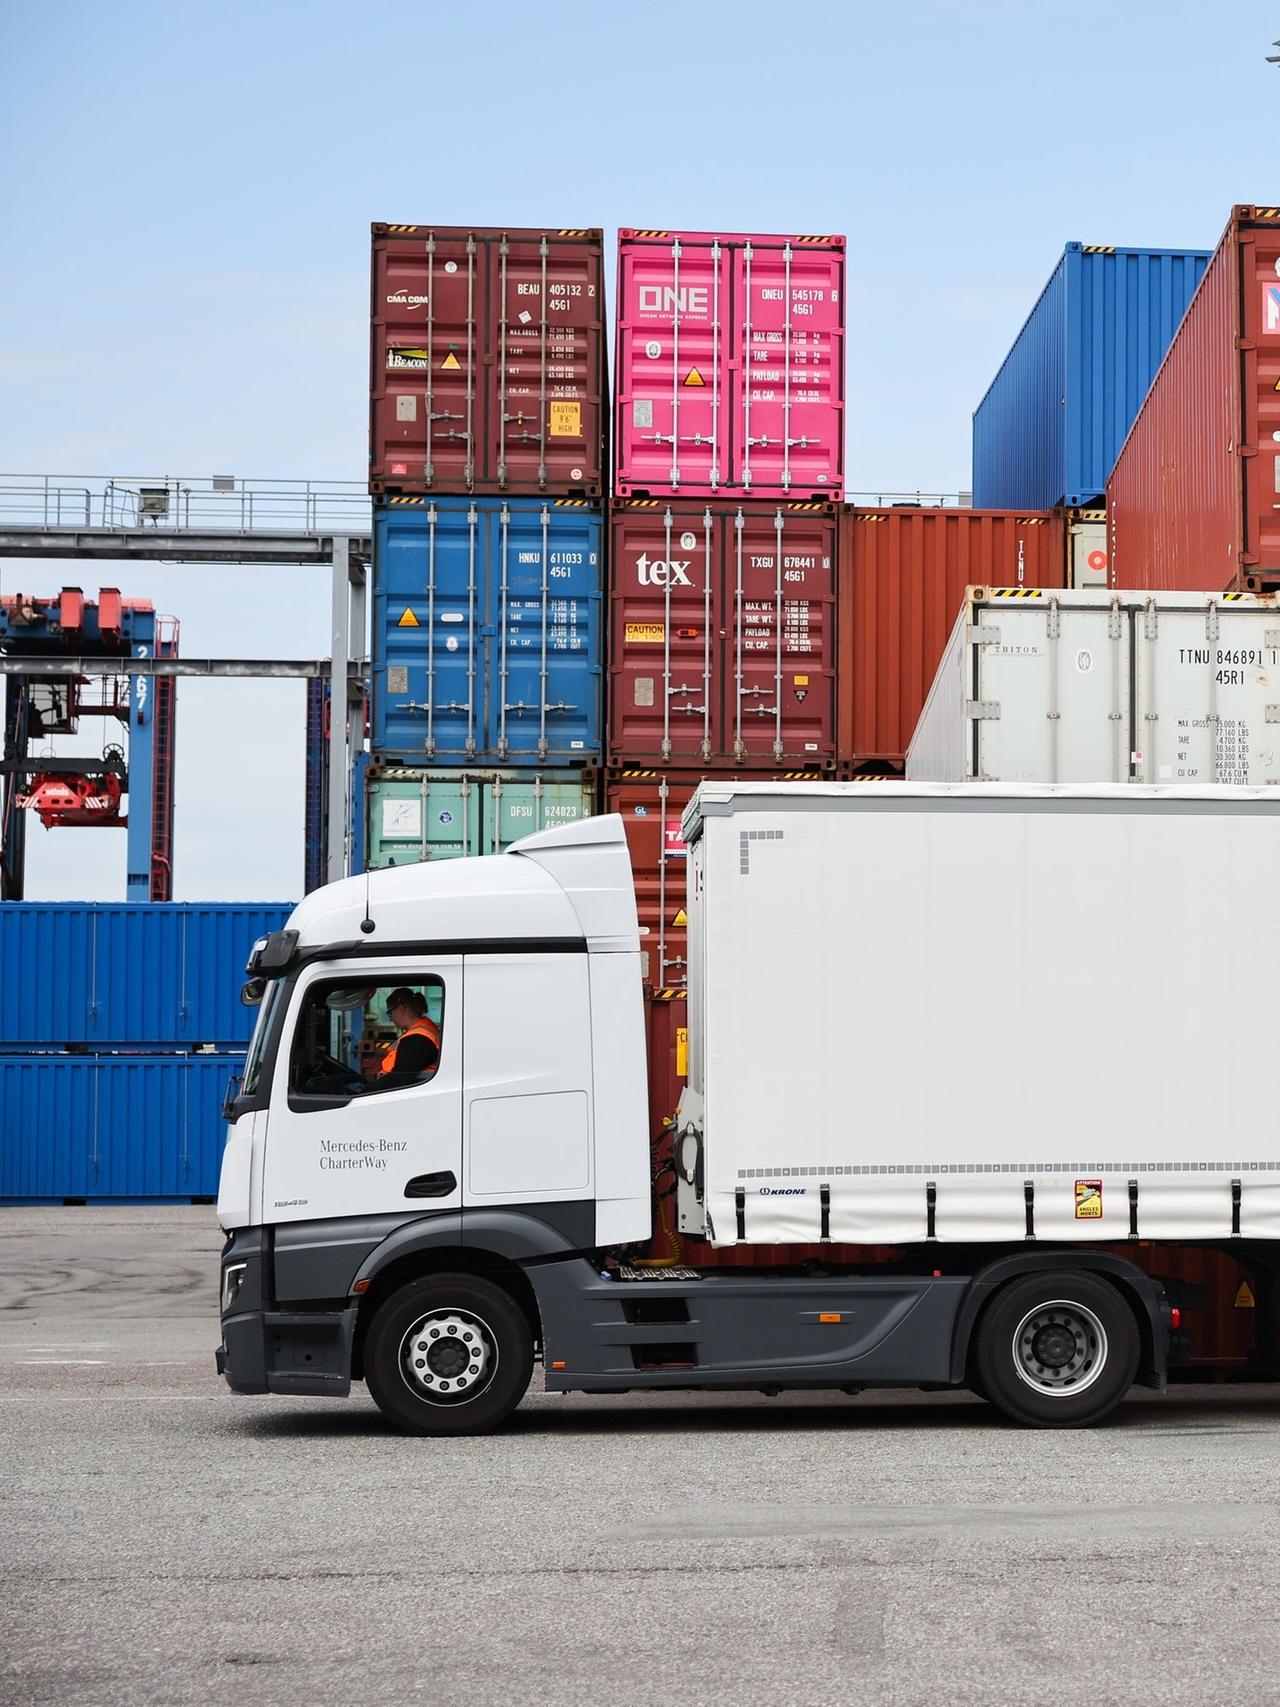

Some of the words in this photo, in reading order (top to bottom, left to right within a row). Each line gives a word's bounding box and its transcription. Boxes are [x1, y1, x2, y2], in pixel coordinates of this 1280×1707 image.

[518, 284, 540, 294] BEAU
[549, 284, 581, 296] 405132
[588, 285, 595, 296] 2
[762, 289, 784, 300] ONEU
[792, 290, 824, 301] 545178
[832, 290, 838, 302] 6
[408, 296, 428, 304] CGM
[640, 286, 708, 312] ONE
[549, 300, 570, 310] 45G1
[793, 304, 813, 315] 45G1
[753, 332, 765, 342] MAX
[767, 333, 782, 342] GROSS
[753, 351, 768, 362] TARE
[752, 370, 780, 382] PAYLOAD
[552, 405, 578, 413] CAUTION
[558, 424, 572, 432] HIGH
[518, 552, 540, 564] HNKU
[550, 553, 582, 564] 611033
[750, 556, 774, 568] TXGU
[784, 557, 815, 568] 676441
[550, 567, 572, 578] 45G1
[784, 571, 805, 582] 45G1
[745, 602, 760, 610] MAX.
[746, 615, 760, 624] TARE
[762, 616, 774, 624] WT.
[745, 628, 770, 636] PAYLOAD
[756, 641, 770, 650] CAP.
[1180, 650, 1210, 664] TTNU
[1216, 650, 1262, 664] 846891
[1216, 670, 1244, 684] 45R1
[1178, 736, 1190, 744] TARE
[1178, 752, 1187, 760] NET
[510, 806, 532, 816] DFSU
[544, 806, 577, 816] 624023
[320, 1140, 408, 1152] Mercedes-Benz
[320, 1156, 388, 1171] CharterWay
[771, 1188, 806, 1196] KRONE
